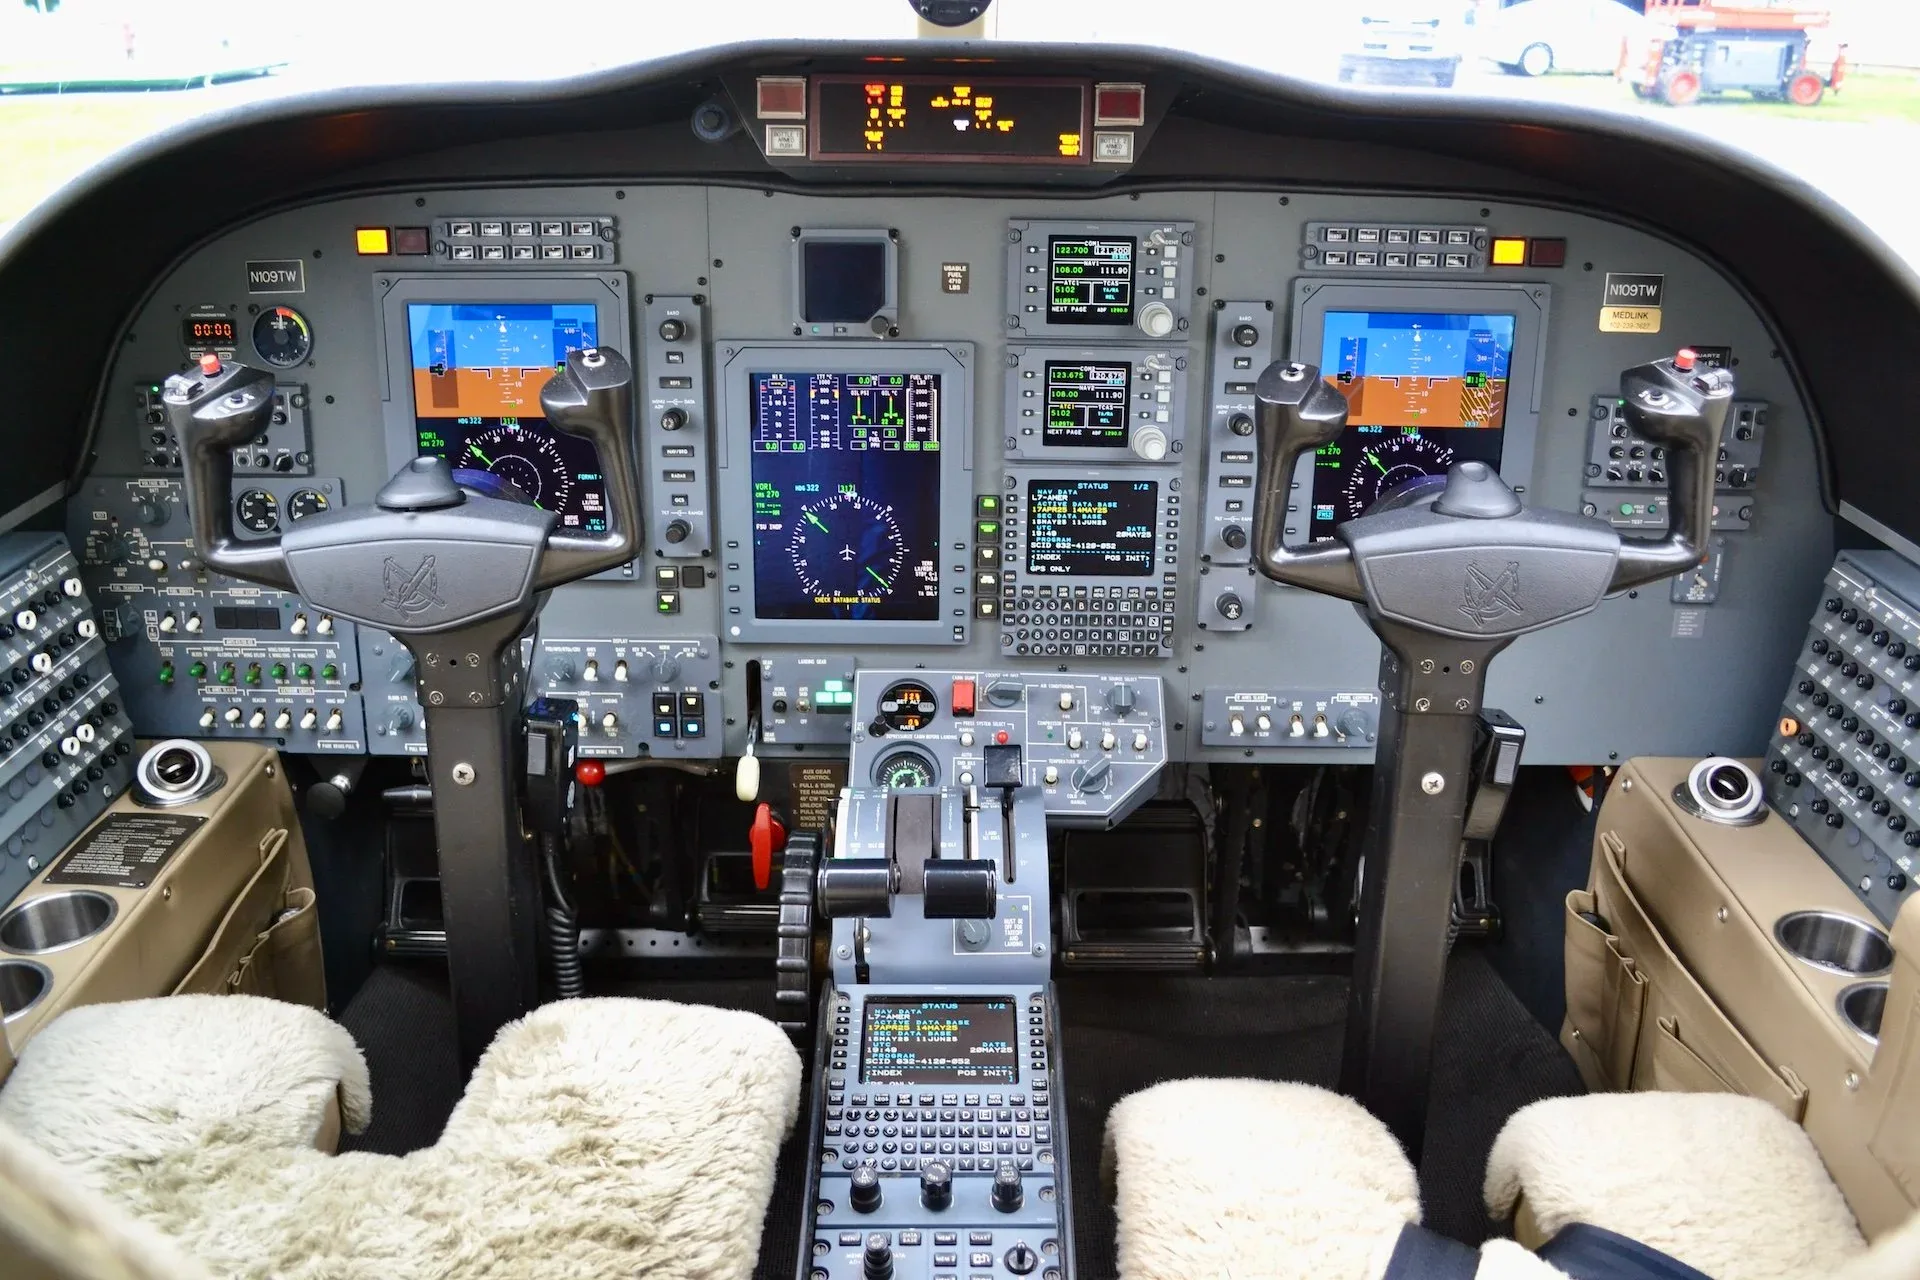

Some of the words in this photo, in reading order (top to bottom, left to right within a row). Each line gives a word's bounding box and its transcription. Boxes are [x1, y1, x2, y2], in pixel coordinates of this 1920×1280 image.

[250, 271, 296, 282] N109TW
[1610, 285, 1657, 296] N109TW
[194, 324, 232, 339] 00:00
[432, 439, 445, 447] 270
[806, 484, 819, 492] 322
[840, 484, 853, 492] 317
[1078, 602, 1084, 610] B
[1093, 602, 1099, 610] C
